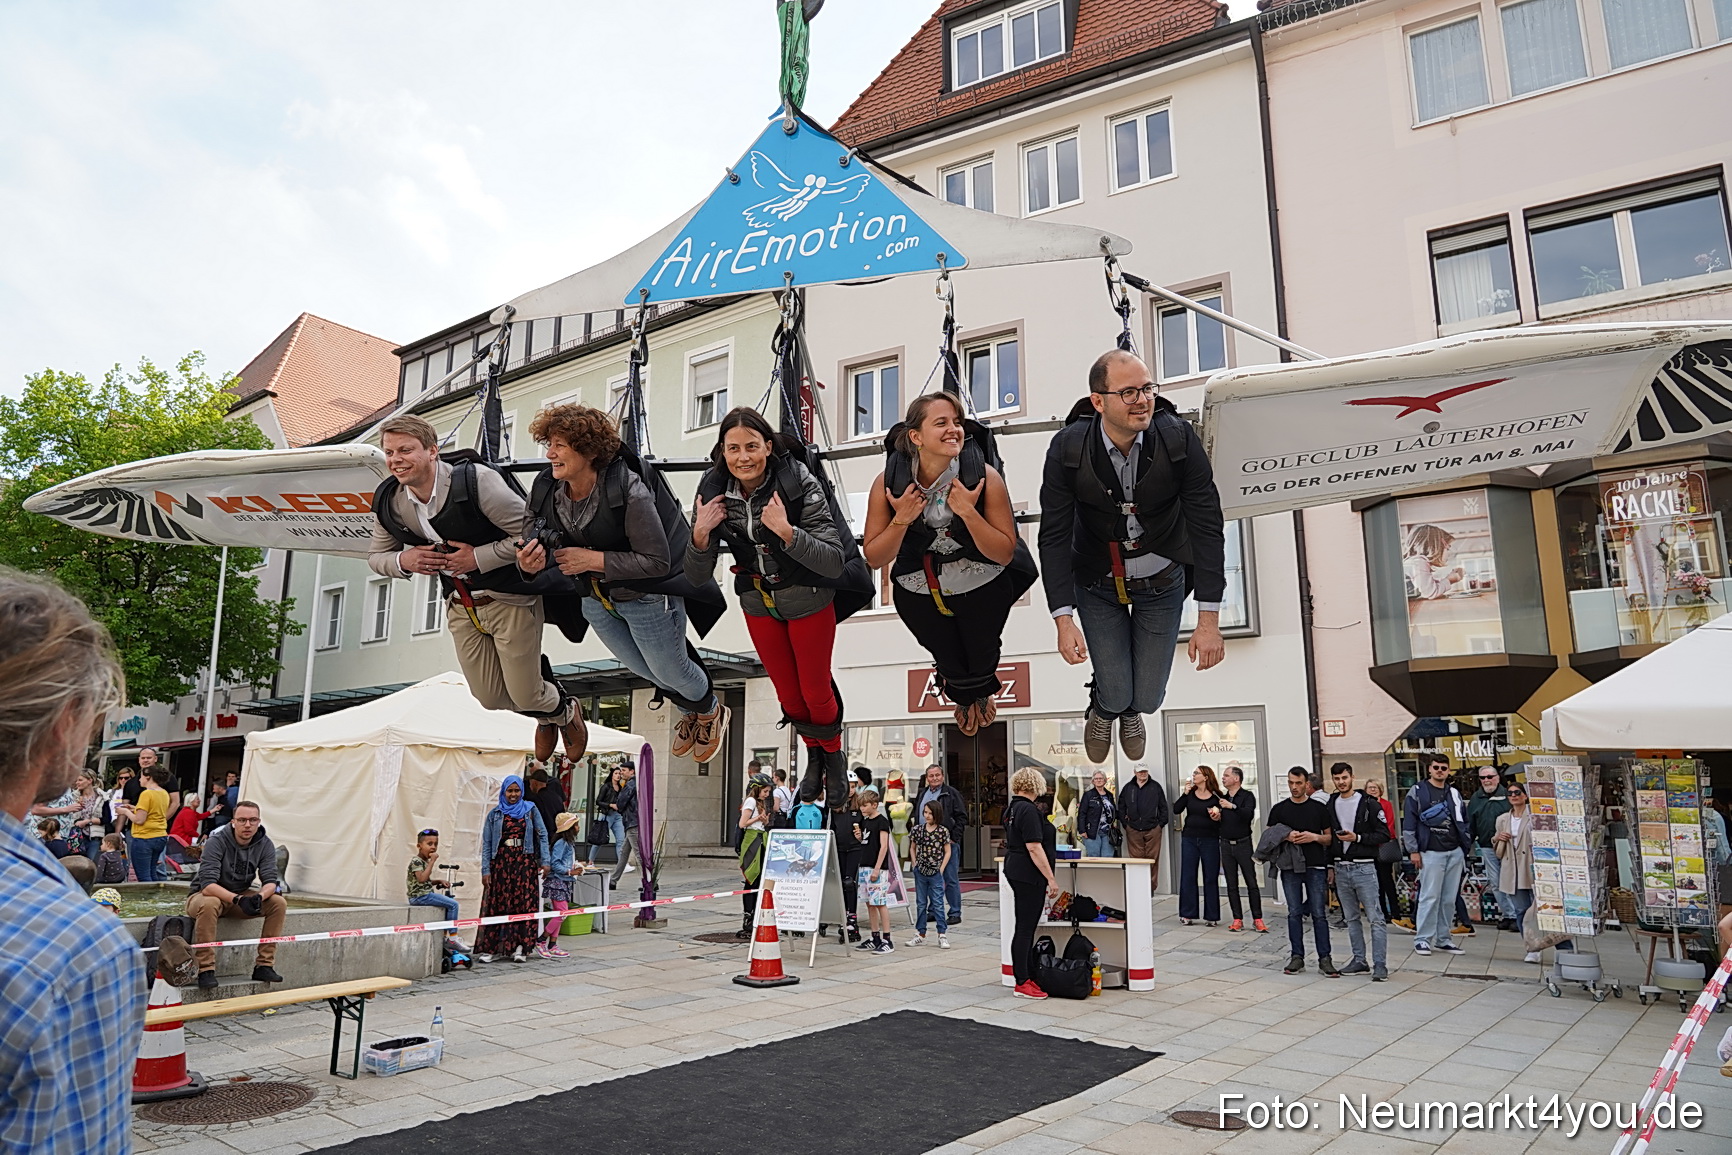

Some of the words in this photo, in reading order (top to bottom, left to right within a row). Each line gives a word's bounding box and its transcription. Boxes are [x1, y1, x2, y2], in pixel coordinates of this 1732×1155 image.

[651, 211, 906, 287] AirEmotion
[877, 236, 919, 260] .com
[1241, 444, 1379, 474] GOLFCLUB
[1394, 412, 1589, 453] LAUTERHOFEN
[1240, 483, 1277, 496] TAG
[1283, 477, 1321, 490] DER
[1327, 465, 1416, 484] OFFENEN
[1424, 456, 1463, 471] TÜR
[1468, 451, 1503, 465] AM
[1508, 446, 1525, 458] 8.
[1532, 439, 1575, 455] MAI
[1616, 478, 1640, 493] 100
[1645, 470, 1687, 490] Jahre
[1611, 489, 1682, 520] RACKL
[257, 514, 325, 523] BAUPARTNER
[325, 515, 338, 523] IN
[339, 515, 374, 523] DEUTS
[876, 750, 903, 760] Achatz
[1047, 743, 1078, 755] Achatz
[1199, 741, 1234, 753] Achatz
[1453, 740, 1495, 757] RACKL
